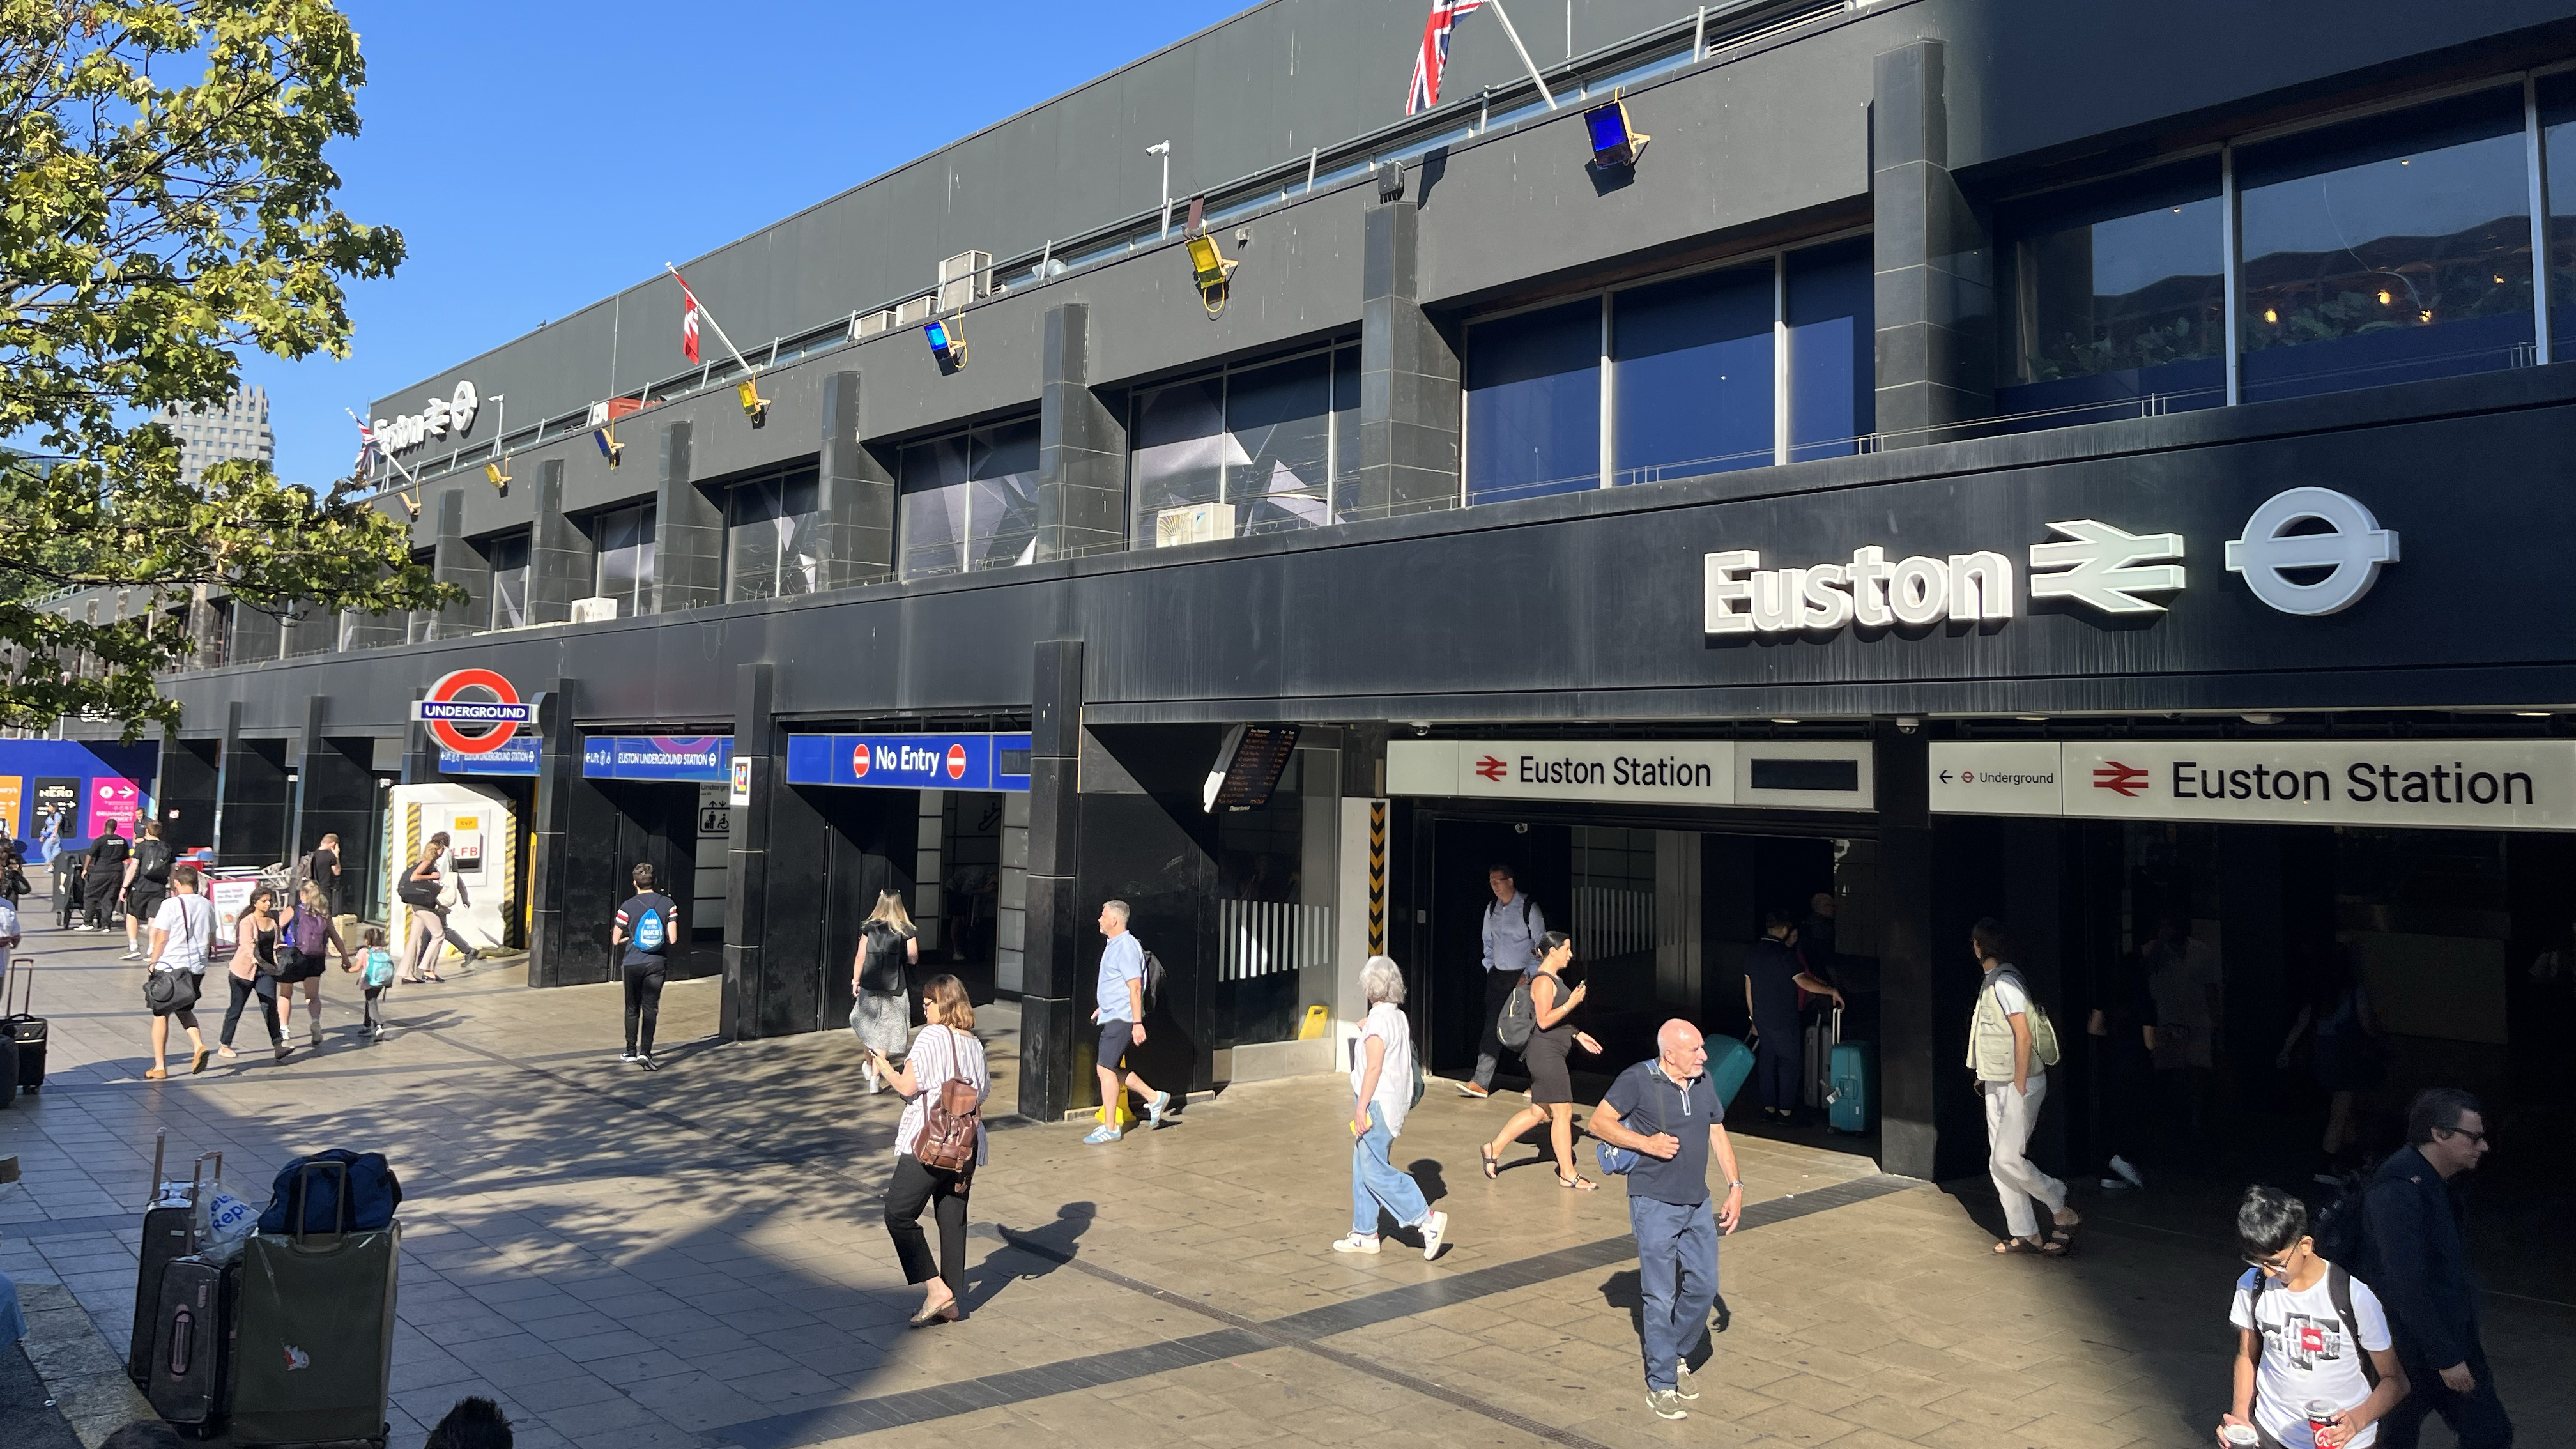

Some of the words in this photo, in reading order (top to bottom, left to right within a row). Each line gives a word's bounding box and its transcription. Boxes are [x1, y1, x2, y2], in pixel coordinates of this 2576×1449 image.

[374, 415, 424, 452] Euston
[1704, 544, 2014, 634] Euston
[425, 705, 525, 717] UNDERGROUND
[480, 751, 510, 761] UNDERGROUND
[511, 752, 528, 761] STATION
[590, 752, 599, 763] Lift
[618, 753, 639, 764] EUSTON
[640, 753, 682, 765] UNDERGROUND
[683, 753, 707, 765] STATION
[876, 746, 896, 770] No
[901, 746, 940, 776] Entry
[1519, 755, 1604, 785] Euston
[1613, 756, 1712, 788] Station
[1979, 772, 2054, 786] Underground
[2172, 760, 2331, 801] Euston
[2347, 761, 2534, 805] Station
[39, 789, 74, 797] NERO
[452, 847, 478, 857] LFB
